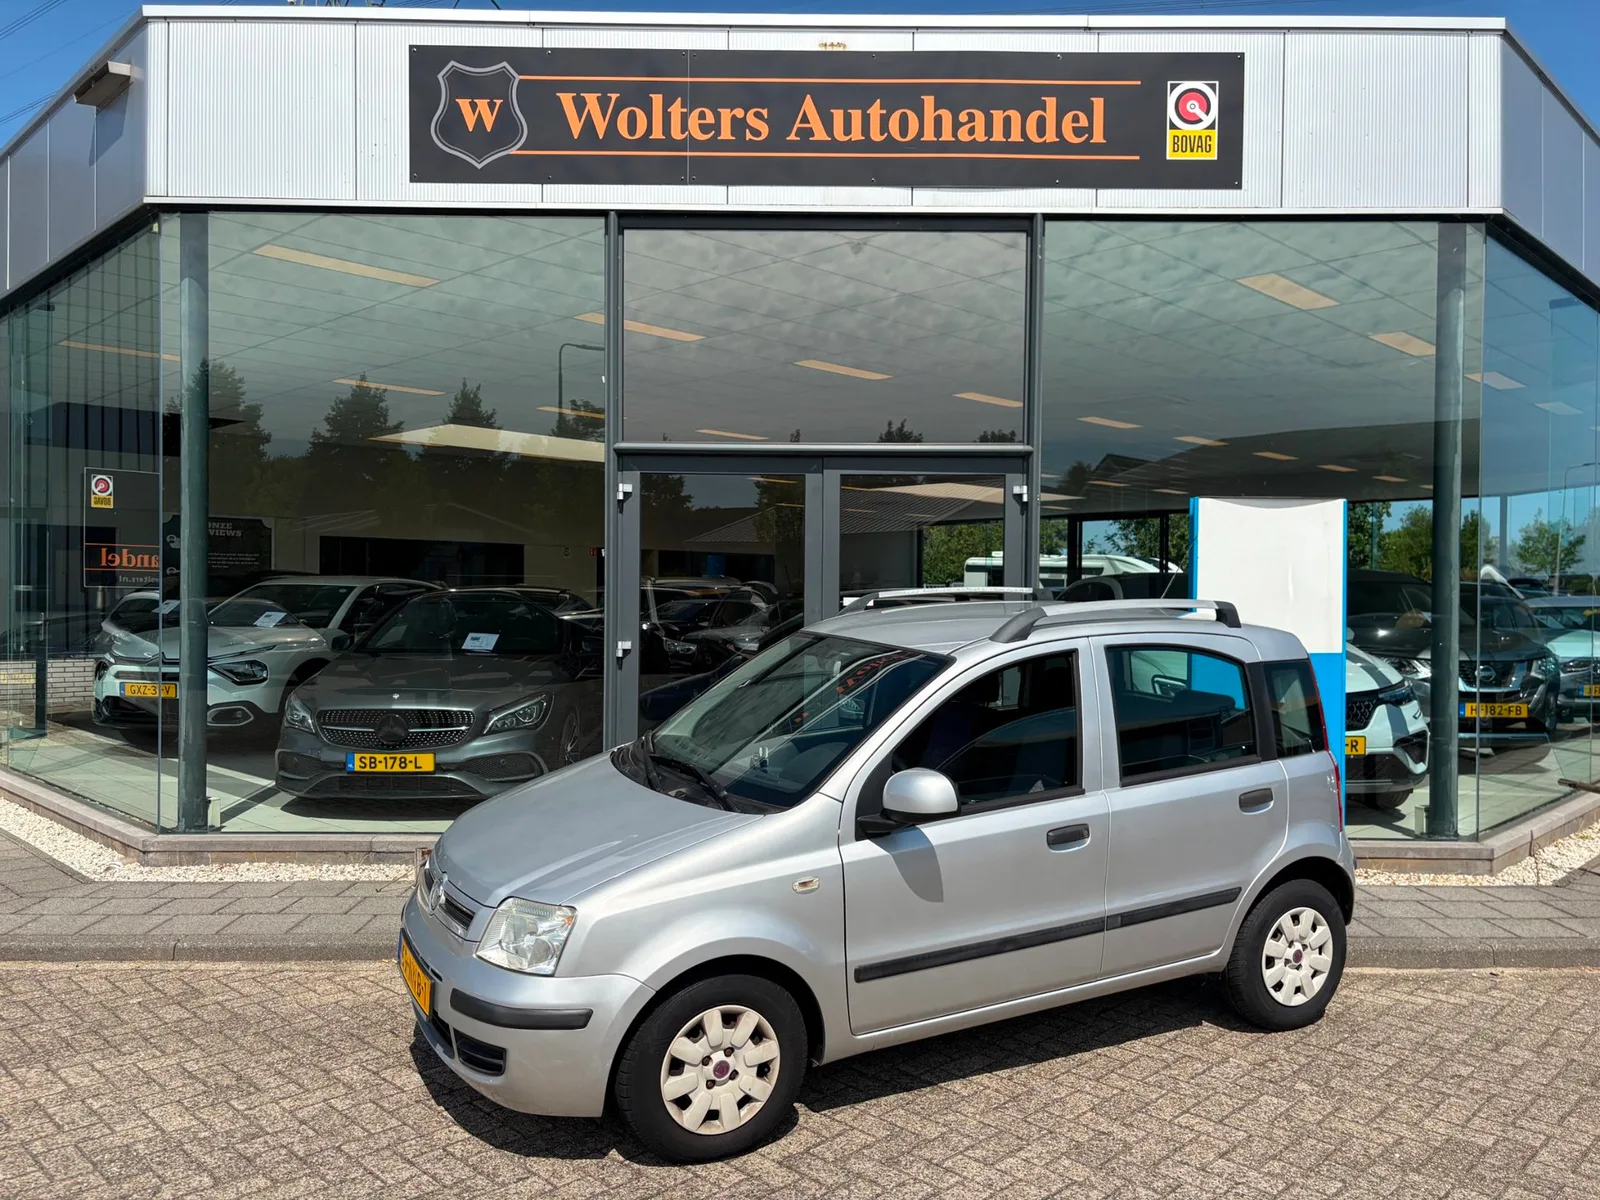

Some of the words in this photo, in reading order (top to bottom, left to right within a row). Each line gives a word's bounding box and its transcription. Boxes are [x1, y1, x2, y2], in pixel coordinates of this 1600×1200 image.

[455, 98, 504, 132] W
[556, 92, 770, 142] Wolters
[786, 94, 1107, 144] Autohandel
[1172, 134, 1212, 154] BOVAG
[130, 684, 171, 696] GXZ-3-V
[358, 755, 423, 770] SB-178-L
